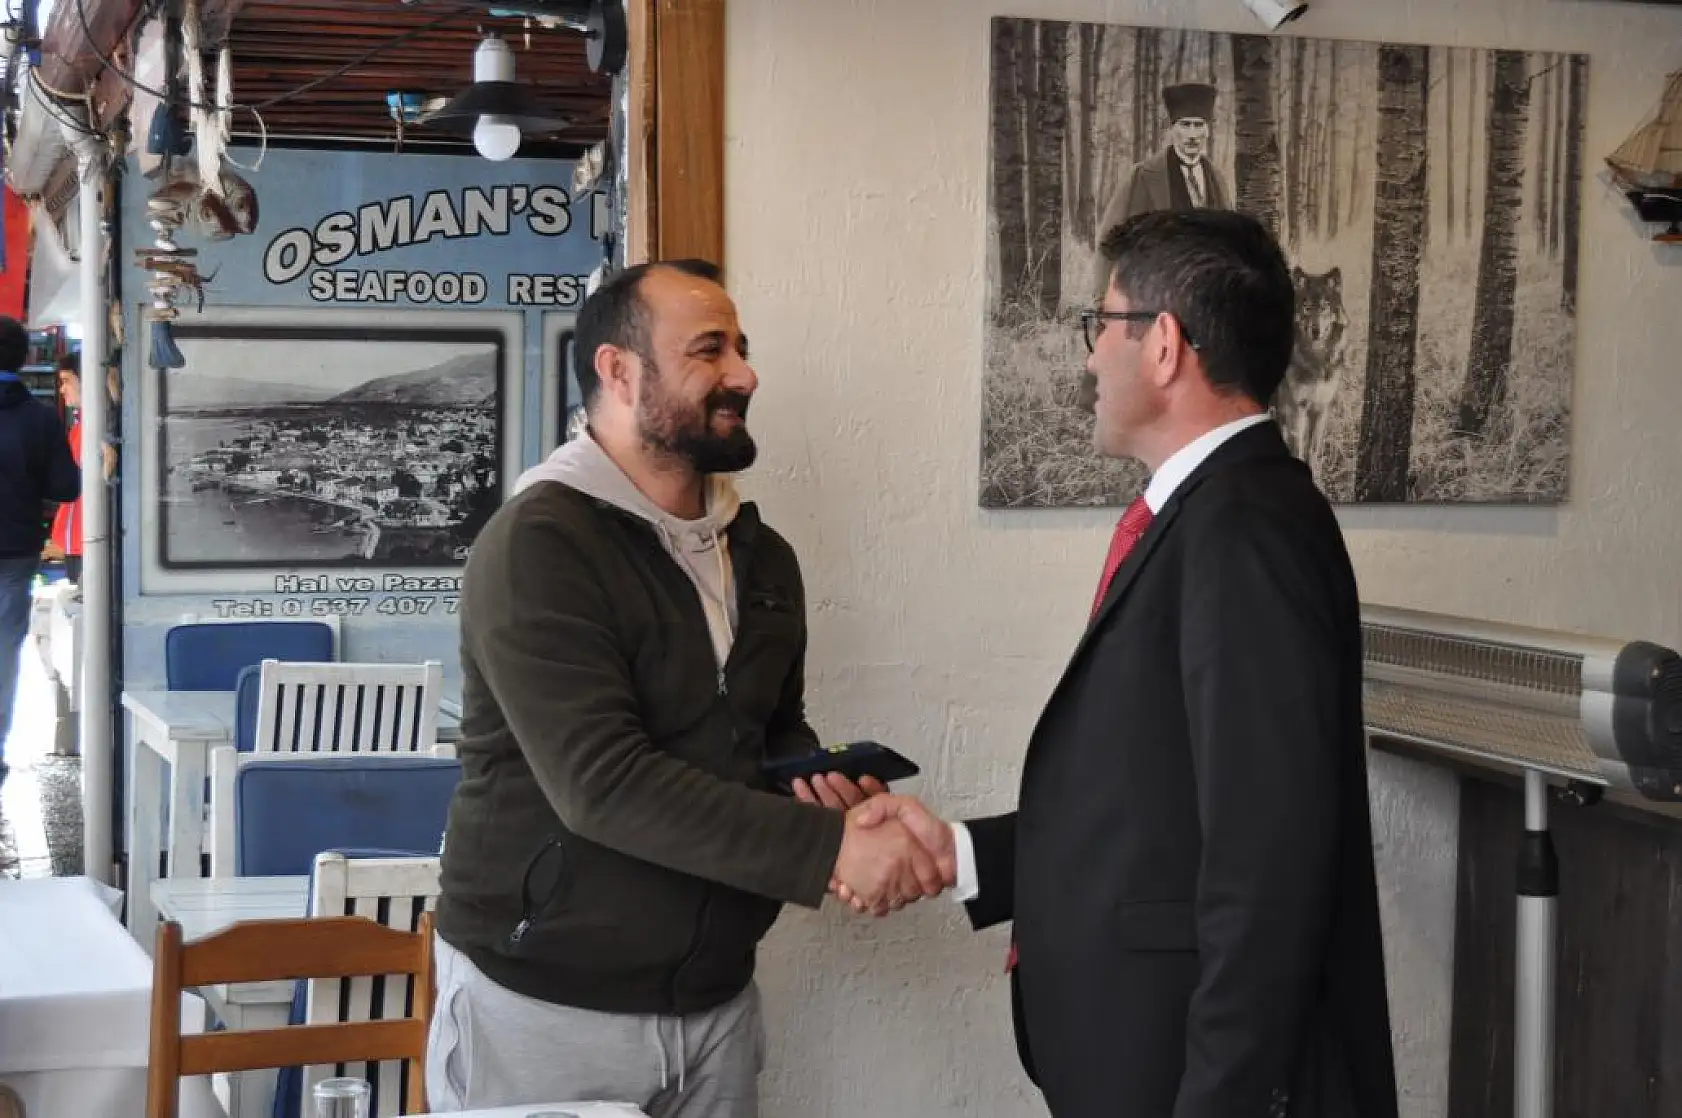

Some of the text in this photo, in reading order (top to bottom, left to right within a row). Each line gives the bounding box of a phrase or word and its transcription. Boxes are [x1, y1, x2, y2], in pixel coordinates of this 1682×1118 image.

[264, 184, 572, 285] OSMAN'S
[309, 269, 488, 304] SEAFOOD
[275, 575, 328, 593] Hal
[337, 577, 375, 592] ve
[213, 599, 273, 618] Tel:
[282, 598, 301, 616] 0
[312, 597, 370, 616] 537
[377, 596, 437, 615] 407
